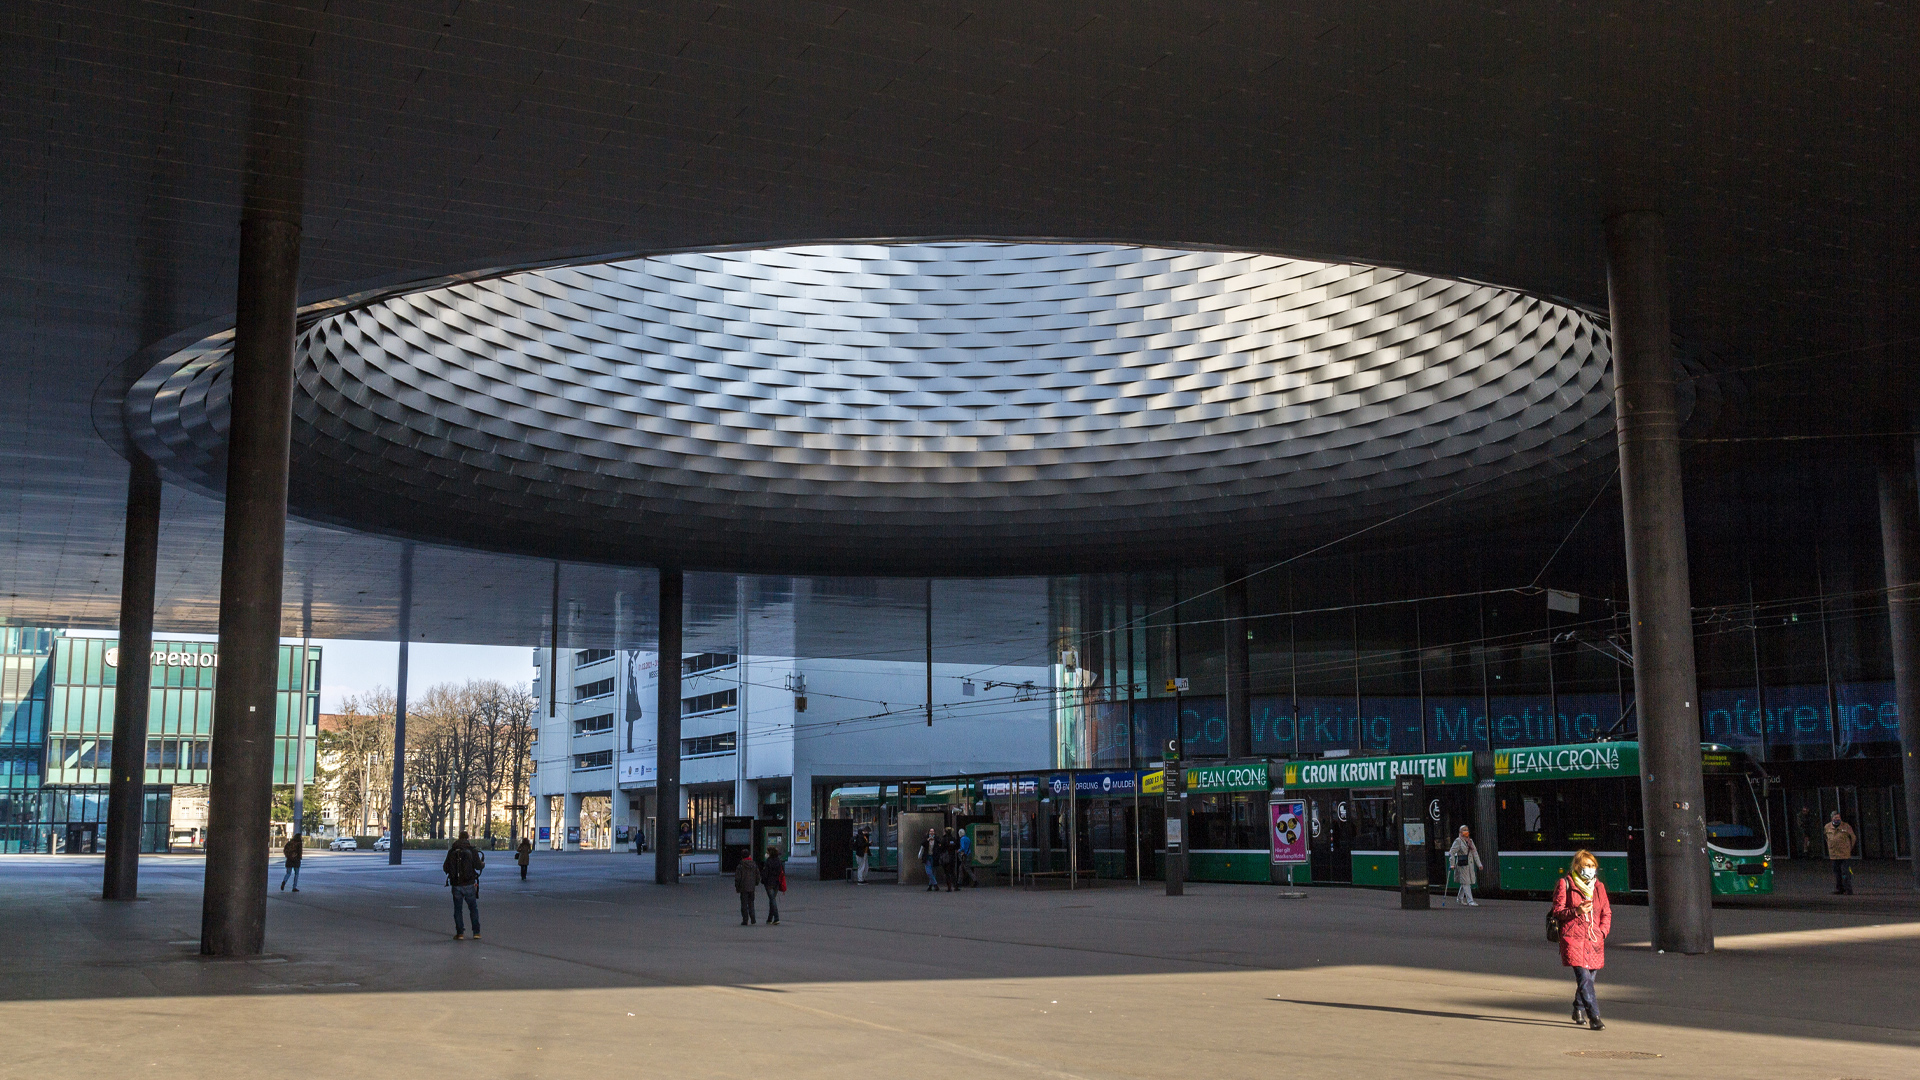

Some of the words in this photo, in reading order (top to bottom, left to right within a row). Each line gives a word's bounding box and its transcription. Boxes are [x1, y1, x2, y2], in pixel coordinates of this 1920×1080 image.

[1435, 707, 1597, 741] Meeting
[1707, 698, 1899, 735] nference
[1168, 739, 1176, 751] C
[1302, 765, 1337, 784] CRON
[1341, 761, 1387, 782] KRÖNT
[1390, 758, 1447, 780] BAUTEN
[1509, 751, 1552, 774] JEAN
[1556, 748, 1611, 772] CRON
[1062, 781, 1098, 791] ENORGUNG
[1197, 770, 1225, 788] JEAN
[1227, 768, 1261, 787] CRON
